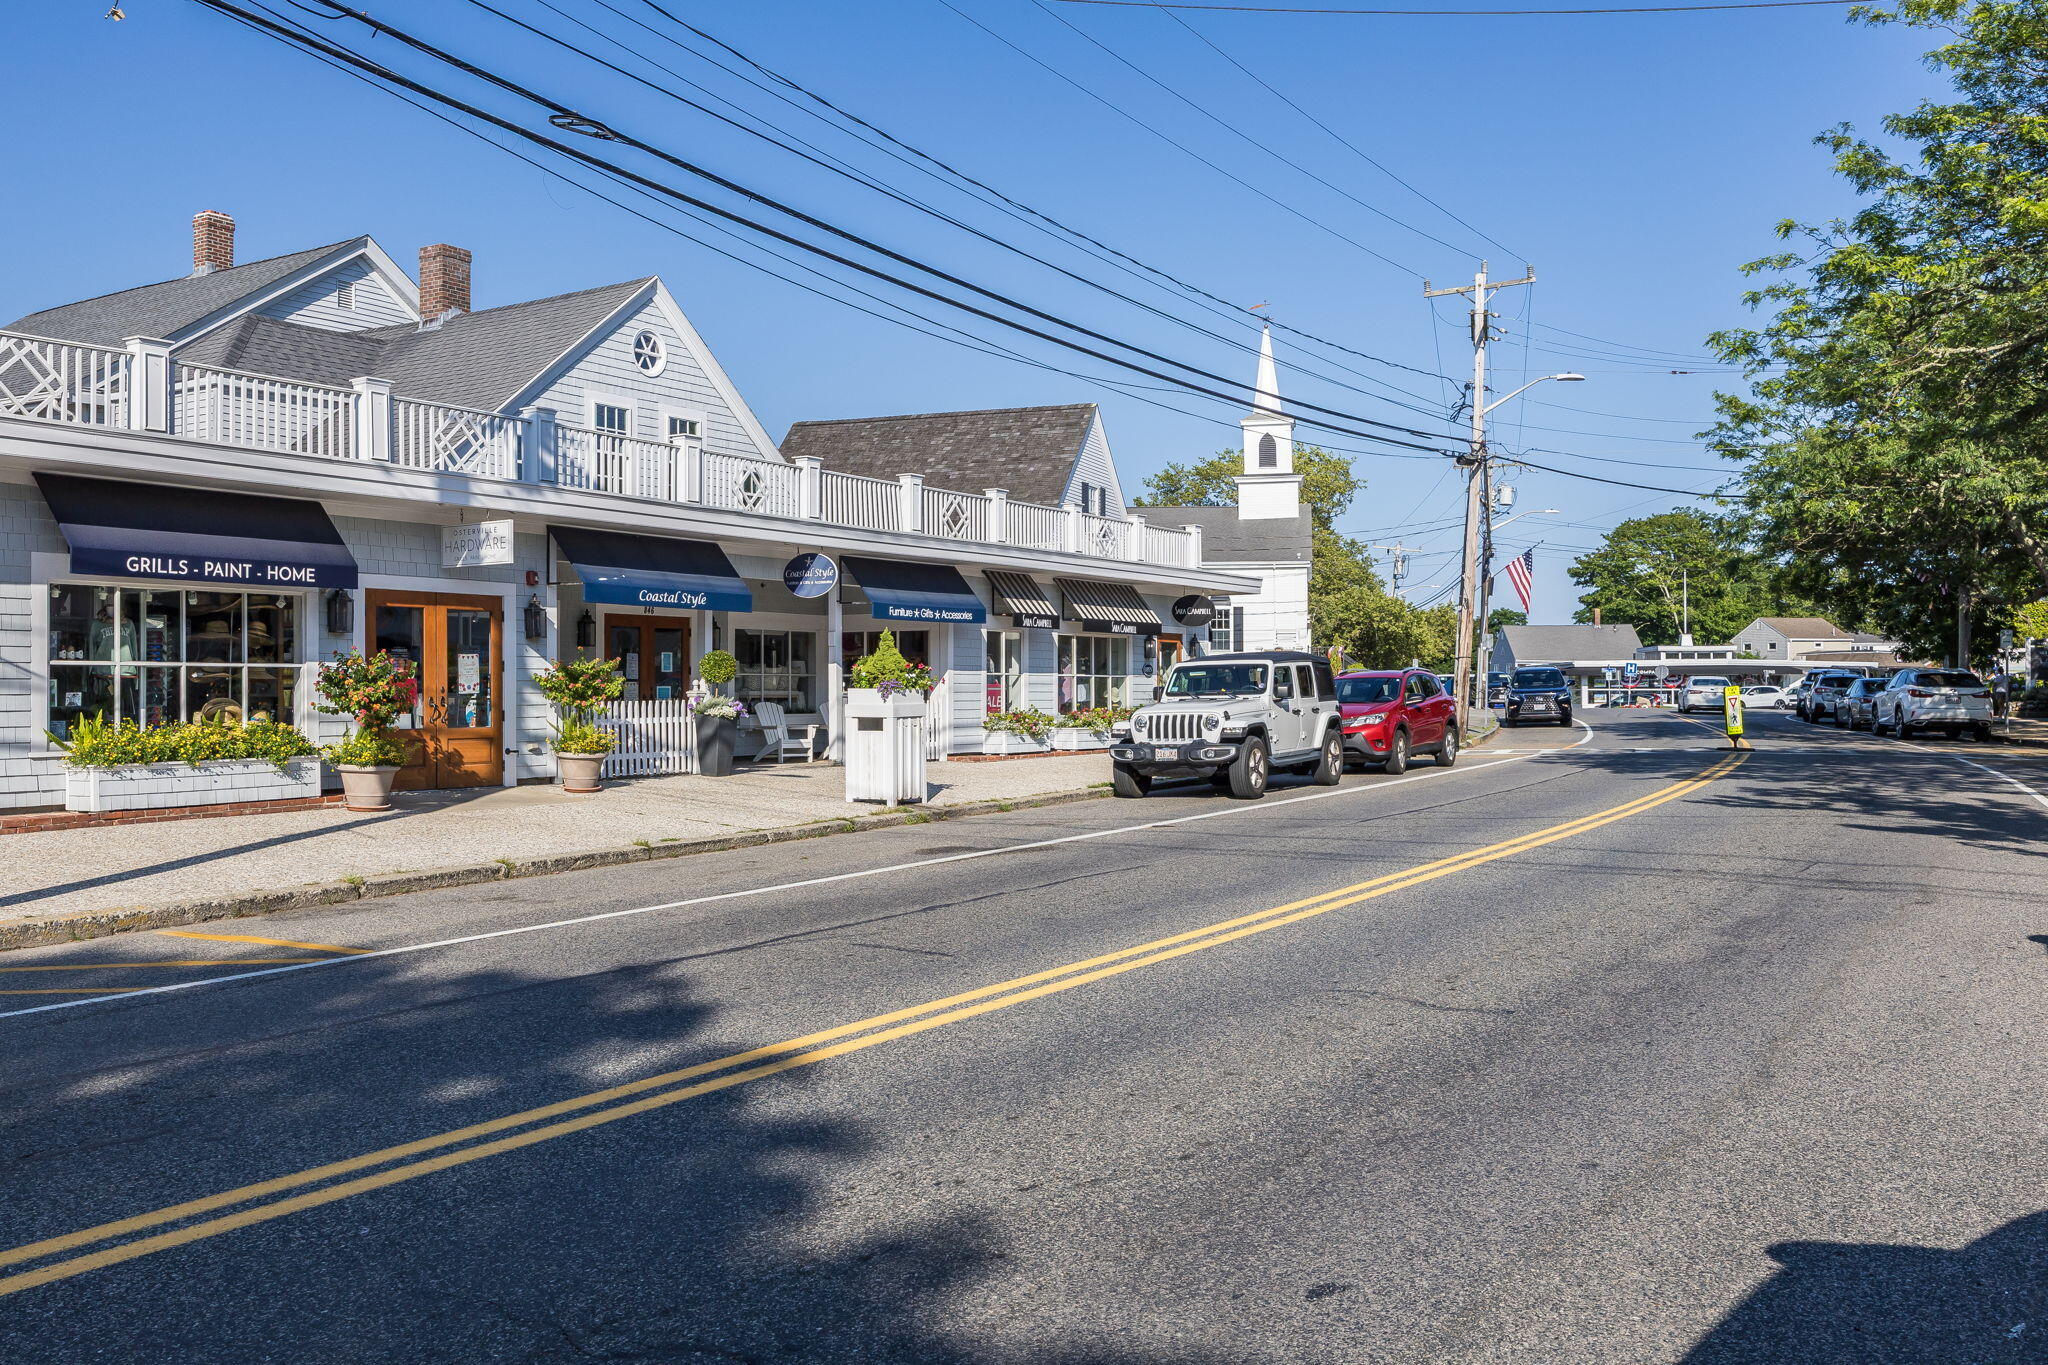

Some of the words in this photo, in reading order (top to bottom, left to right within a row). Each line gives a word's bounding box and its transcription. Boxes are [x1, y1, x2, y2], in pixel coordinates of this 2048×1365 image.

[444, 536, 507, 553] HARDWARE
[126, 557, 188, 575] GRILLS
[204, 562, 252, 579] PAINT
[267, 565, 316, 582] HOME
[785, 567, 814, 578] Coastal
[814, 566, 834, 580] Style
[639, 589, 681, 603] Coastal
[681, 592, 707, 608] Style
[889, 606, 913, 617] Furniture
[920, 608, 934, 618] Gifts
[941, 610, 973, 620] Accessories
[1628, 664, 1635, 673] H
[987, 695, 1002, 707] ALE
